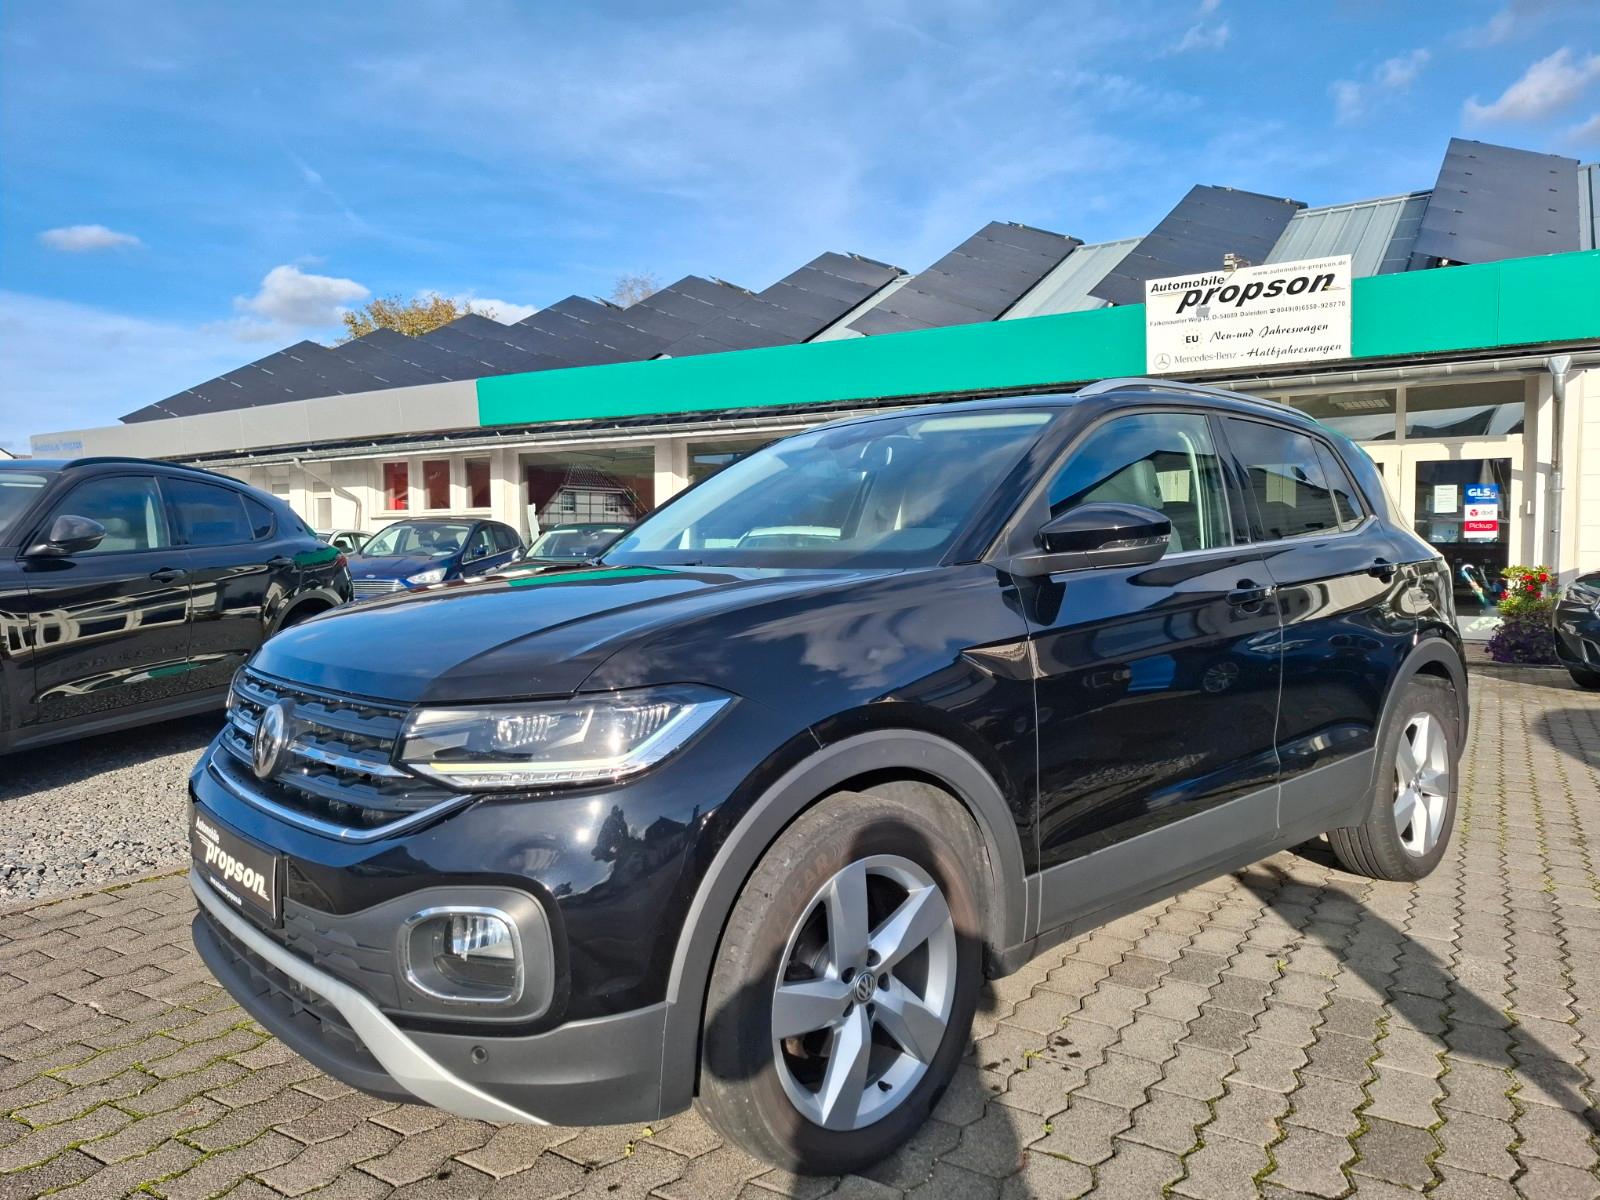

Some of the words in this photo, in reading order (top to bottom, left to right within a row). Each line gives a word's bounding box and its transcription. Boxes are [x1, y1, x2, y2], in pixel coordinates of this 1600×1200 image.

[1151, 275, 1225, 293] Automobile
[1176, 273, 1335, 314] propson
[1259, 324, 1328, 338] Jahreswagen
[1185, 335, 1199, 343] EU
[1174, 352, 1237, 364] Mercedes-Benz
[1467, 488, 1491, 497] GLS
[1468, 522, 1494, 530] Pickup
[205, 841, 265, 896] propson
